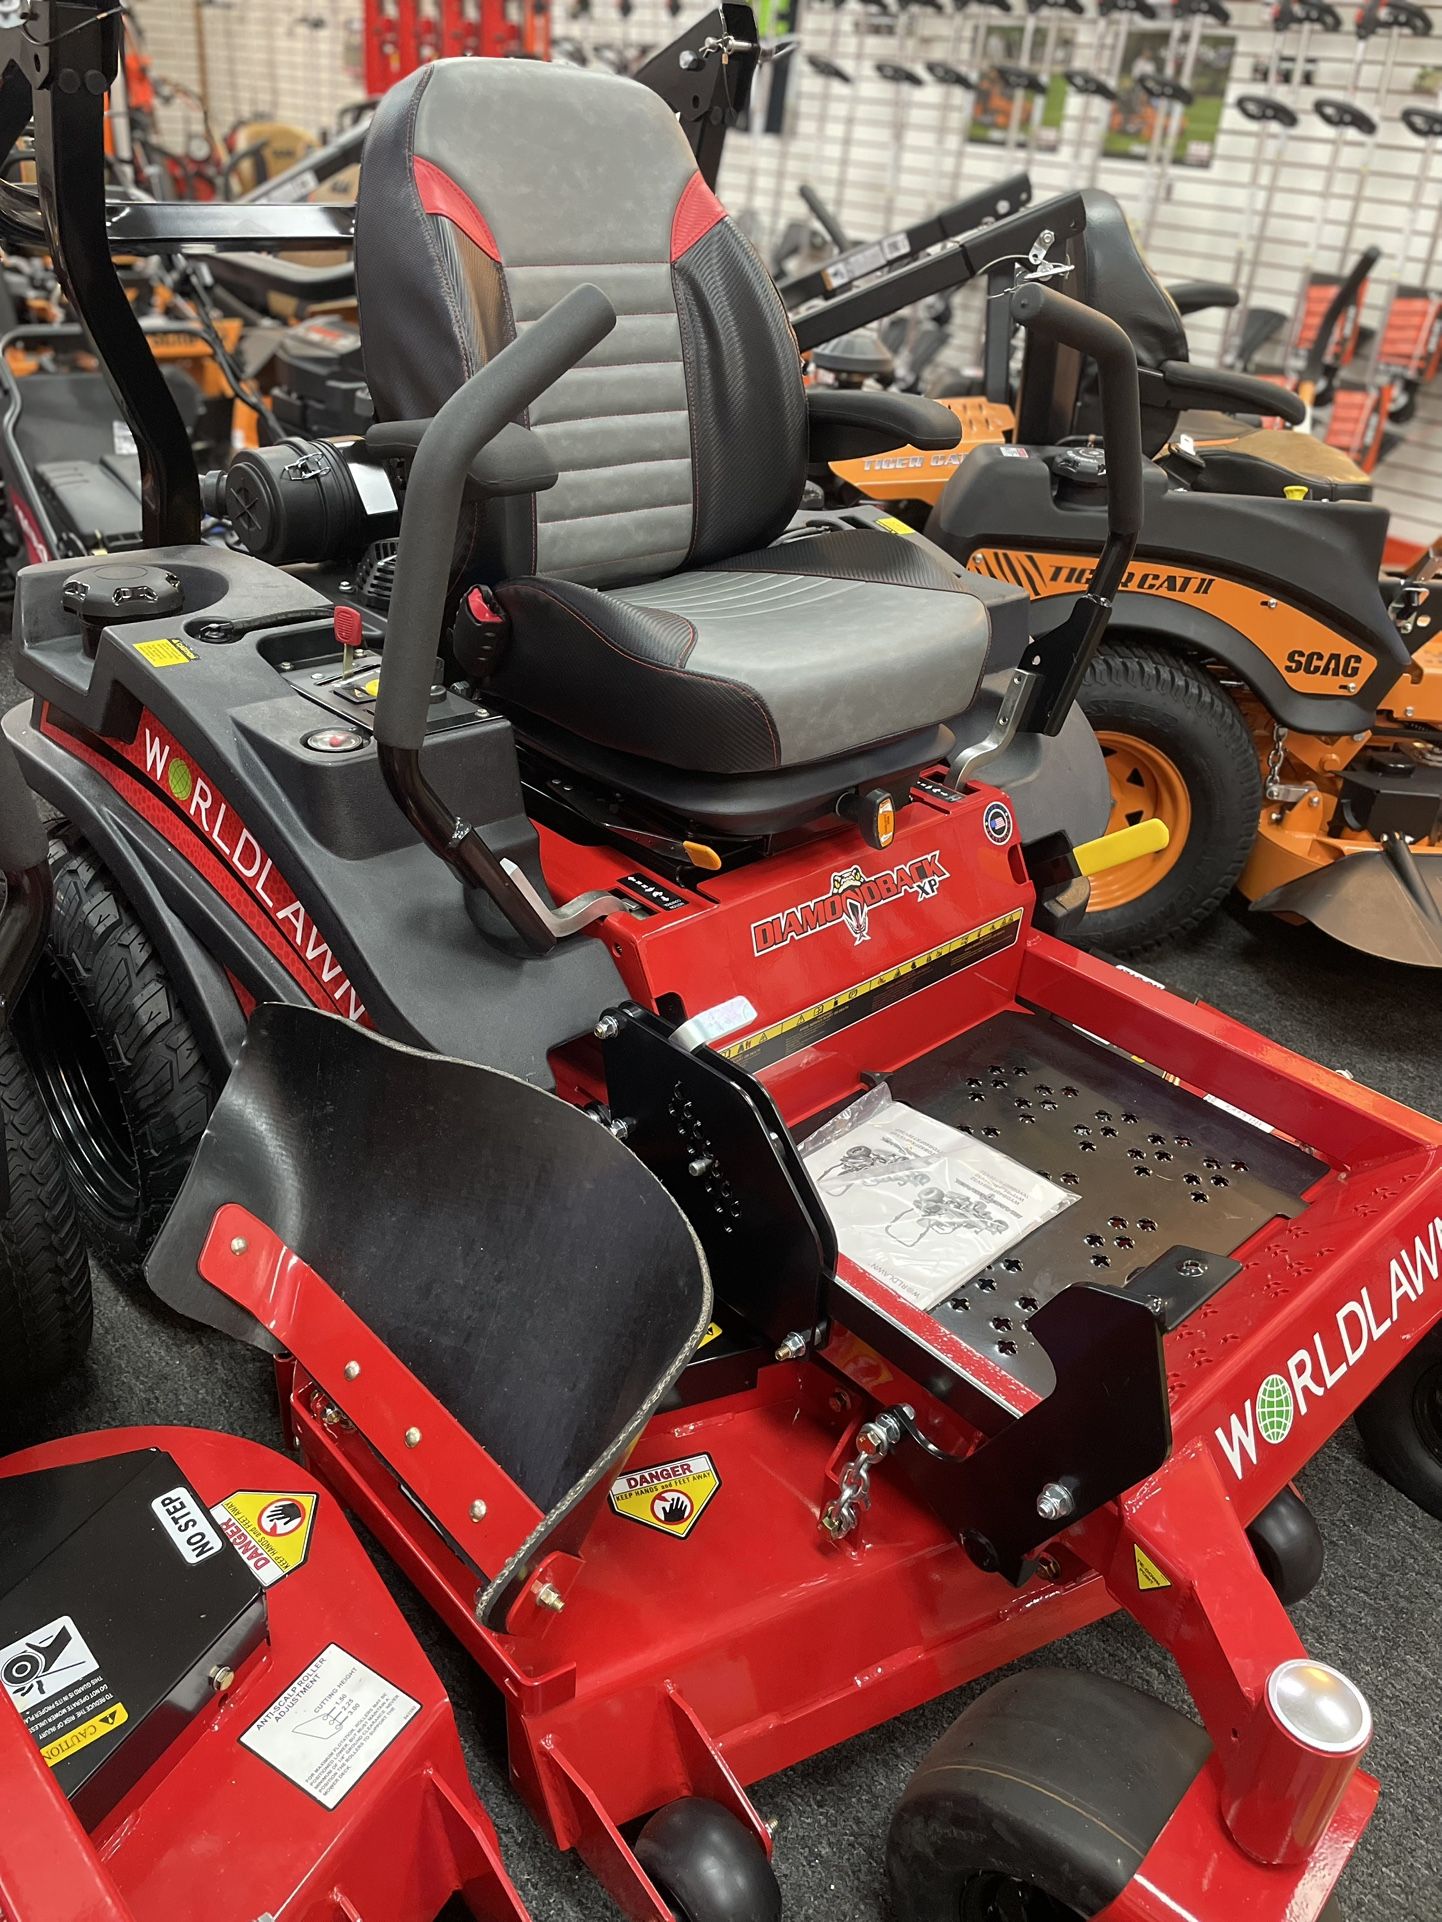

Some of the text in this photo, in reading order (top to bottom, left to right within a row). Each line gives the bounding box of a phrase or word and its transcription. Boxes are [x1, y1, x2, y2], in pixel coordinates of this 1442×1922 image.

[863, 453, 968, 471] TIGER CA
[1049, 565, 1135, 588] TIGR
[1284, 649, 1363, 678] SCAG
[915, 877, 940, 899] XP
[749, 850, 947, 954] DIAMONDBACK
[626, 1462, 692, 1489] DANGER
[616, 1493, 632, 1501] KEEP
[635, 1486, 657, 1496] HANDS
[675, 1477, 689, 1486] FEET
[692, 1472, 710, 1480] AWAY
[160, 1492, 214, 1557] NO STEP
[224, 1500, 289, 1569] KEEP HANDS and FEET AWAY
[219, 1517, 270, 1570] DANGER
[72, 1681, 91, 1694] GUARD
[90, 1675, 102, 1684] THIS
[89, 1688, 100, 1697] NOT
[255, 1656, 326, 1730] ANTI-SCALP ROLLER
[273, 1673, 321, 1722] ADJUSTMENT
[313, 1666, 357, 1713] CUTTING HEIGHT
[54, 1698, 63, 1706] ITS
[66, 1695, 89, 1711] OPERATE
[85, 1696, 105, 1711] REDUCE
[341, 1697, 353, 1711] 2.25
[348, 1702, 360, 1715] 3.00
[33, 1703, 55, 1718] PROPER
[47, 1708, 66, 1722] MOWER
[75, 1708, 85, 1717] THE
[22, 1715, 34, 1724] PLA
[62, 1714, 75, 1724] RISK
[38, 1726, 56, 1739] INJURY
[42, 1724, 97, 1761] CAUTION
[305, 1772, 315, 1783] FOR
